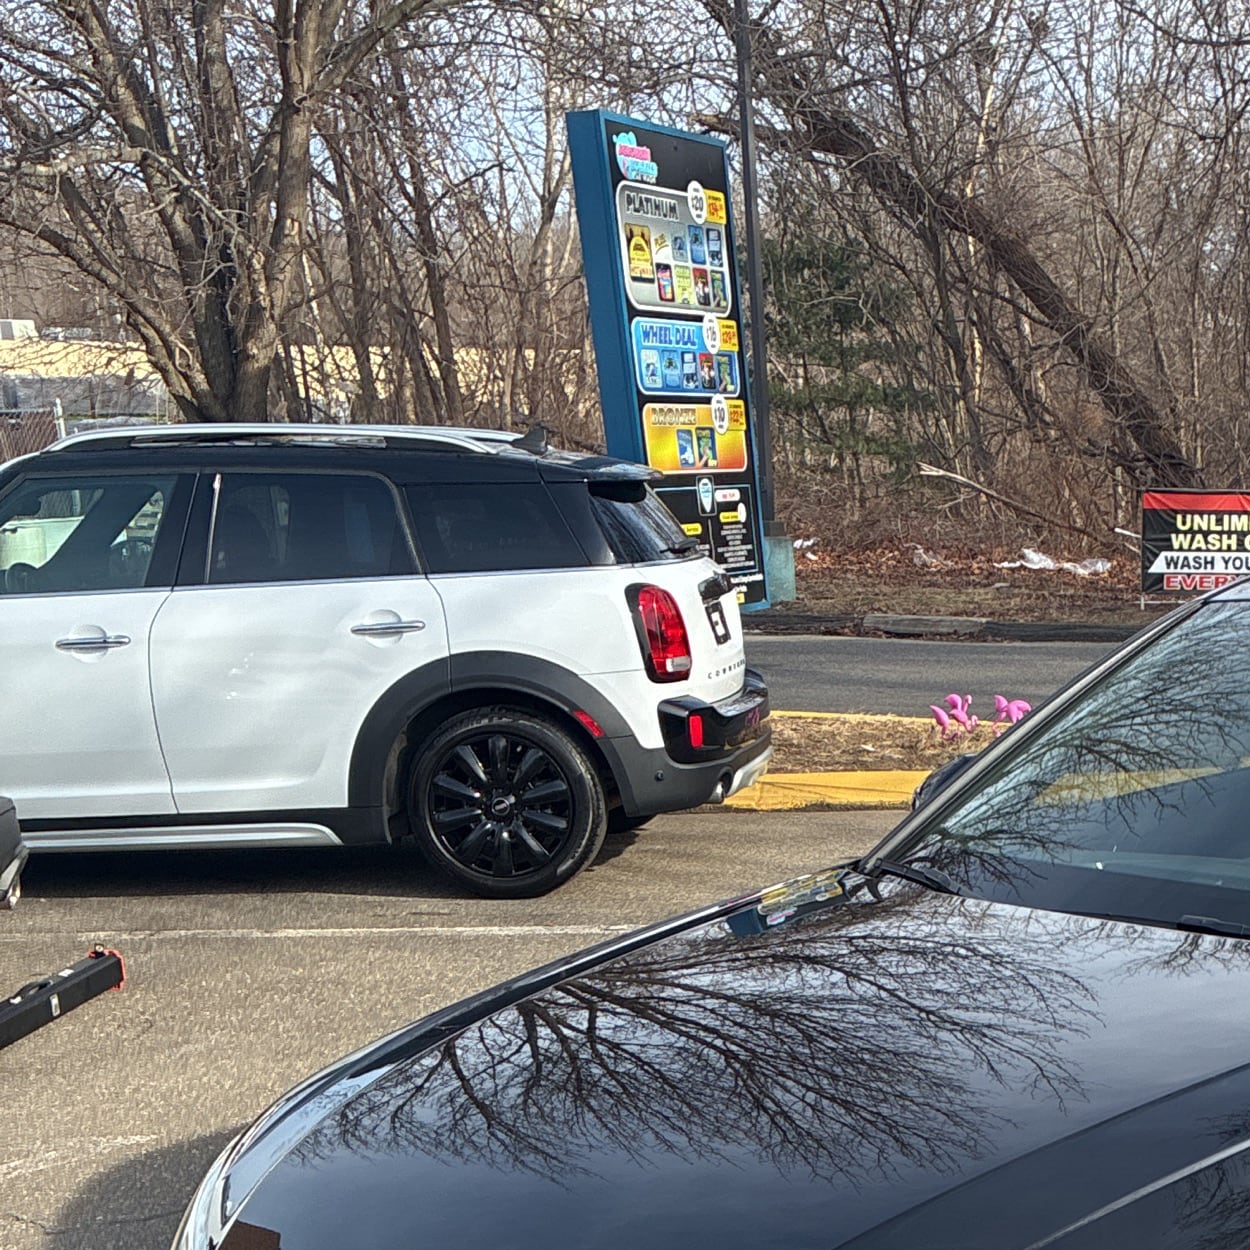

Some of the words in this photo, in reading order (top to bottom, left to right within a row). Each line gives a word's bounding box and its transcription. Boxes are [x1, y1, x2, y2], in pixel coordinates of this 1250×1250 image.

[625, 191, 679, 222] PLATINUM
[640, 322, 672, 346] WHEEL
[673, 326, 697, 348] DEAL
[650, 407, 697, 426] BRONZE
[1170, 534, 1237, 551] WASH
[1164, 555, 1215, 570] WASH
